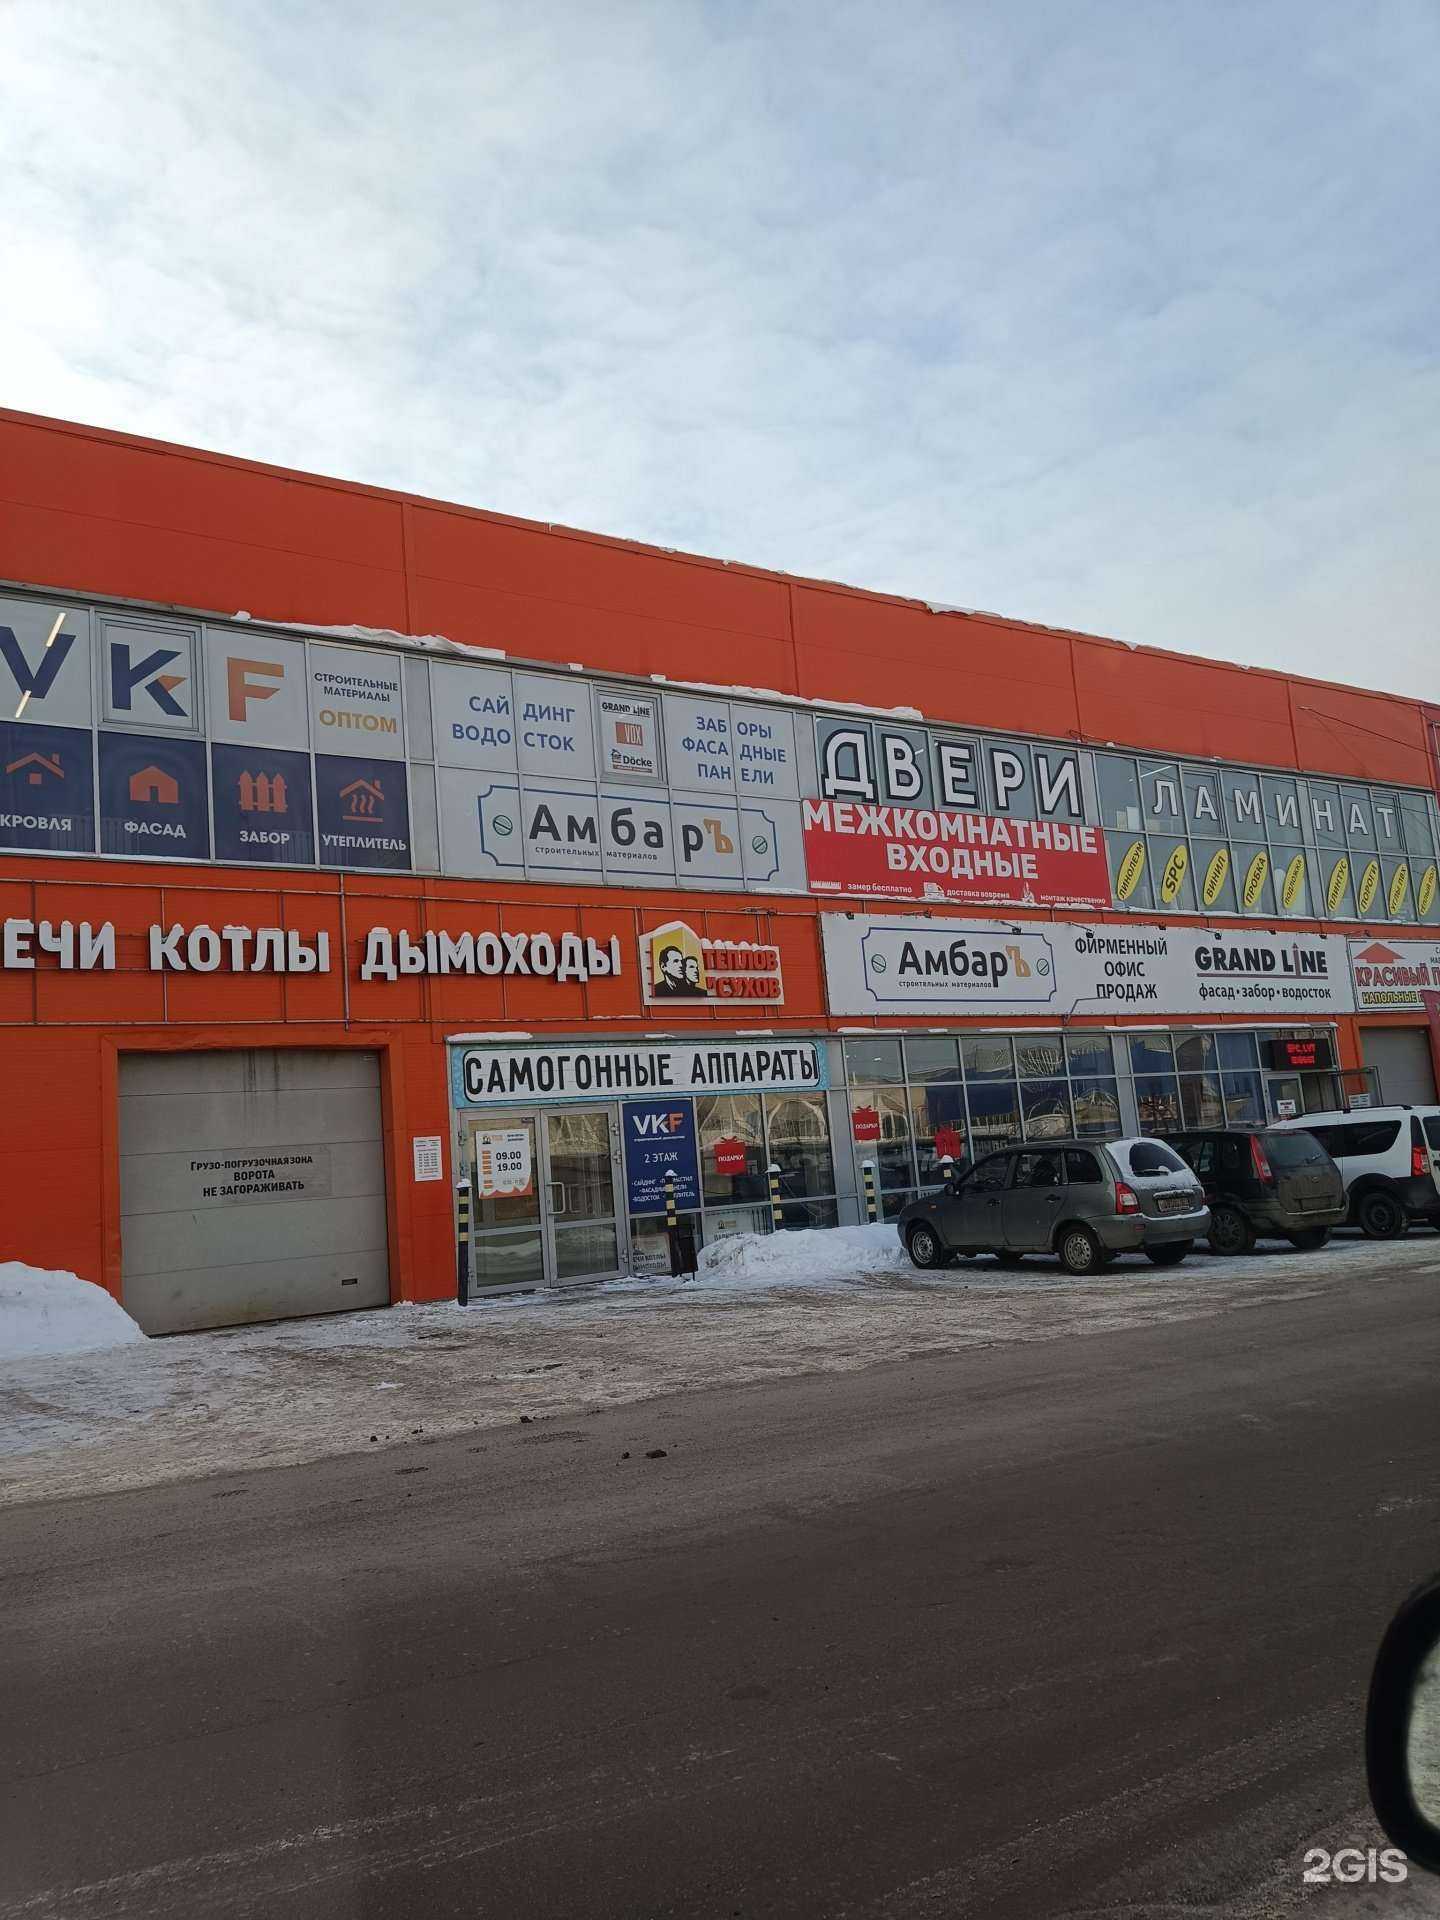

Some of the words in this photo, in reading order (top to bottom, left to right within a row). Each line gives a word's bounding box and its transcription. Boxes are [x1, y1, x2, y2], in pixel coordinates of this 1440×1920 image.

[314, 672, 399, 692] СТРОИТЕЛЬНЫЕ
[323, 686, 391, 702] МАТЕРИАЛЫ
[602, 702, 631, 713] GRAND
[319, 709, 398, 733] ОПТОМ
[821, 728, 1084, 818] ДВЕРИ
[1153, 780, 1394, 838] ЛАМИНАТ
[0, 813, 73, 832] КРОВЛЯ
[124, 820, 187, 839] ФАСАД
[802, 799, 1099, 854] МЕЖКОМНАТНЫЕ
[239, 829, 290, 845] ЗАБОР
[322, 833, 407, 851] УТЕПЛИТЕЛЬ
[535, 845, 600, 857] строительных
[606, 850, 658, 861] материалов
[886, 843, 1040, 880] ВХОДНЫЕ
[1117, 840, 1144, 901] ЛИНОЛЕУМ
[1165, 854, 1185, 895] SPC
[1206, 856, 1228, 899] ВИНИЛ
[1245, 857, 1267, 903] ПРОБКА
[847, 882, 871, 893] замер
[871, 883, 913, 894] бесплатно
[946, 888, 979, 899] доставка
[1327, 860, 1348, 911] ПЛИНТУС
[1360, 863, 1378, 909] ПОРОГИ
[150, 924, 330, 973] КОТЛЫ
[360, 927, 622, 982] ДЫМОХОДЫ
[1074, 937, 1167, 956] ФИРМЕННЫЙ
[703, 948, 778, 971] ТЕПЛОВ
[1195, 946, 1276, 971] GRAND
[1104, 961, 1146, 978] ОФИС
[1355, 963, 1431, 987] КРАСИВЫЙ
[716, 976, 781, 998] СУХОВ
[898, 980, 949, 989] строительных
[1096, 983, 1158, 1001] ПРОДАЖ
[1199, 983, 1235, 1000] фасад
[1242, 983, 1275, 1000] забор
[1282, 987, 1332, 1000] водосток
[1362, 991, 1417, 1004] НАПОЛЬНЫЕ
[465, 1054, 674, 1095] САМОГОННЫЕ
[690, 1049, 819, 1084] АППАРАТЫ
[632, 1113, 684, 1135] VKF
[496, 1151, 521, 1160] 09.00
[644, 1153, 651, 1163] 2
[652, 1152, 679, 1163] ЭТАЖ
[233, 1169, 275, 1182] ВОРОТА
[497, 1162, 522, 1171] 19.00
[203, 1187, 218, 1197] НЕ
[219, 1180, 305, 1196] ЗАГОРАЖИВАТЬ
